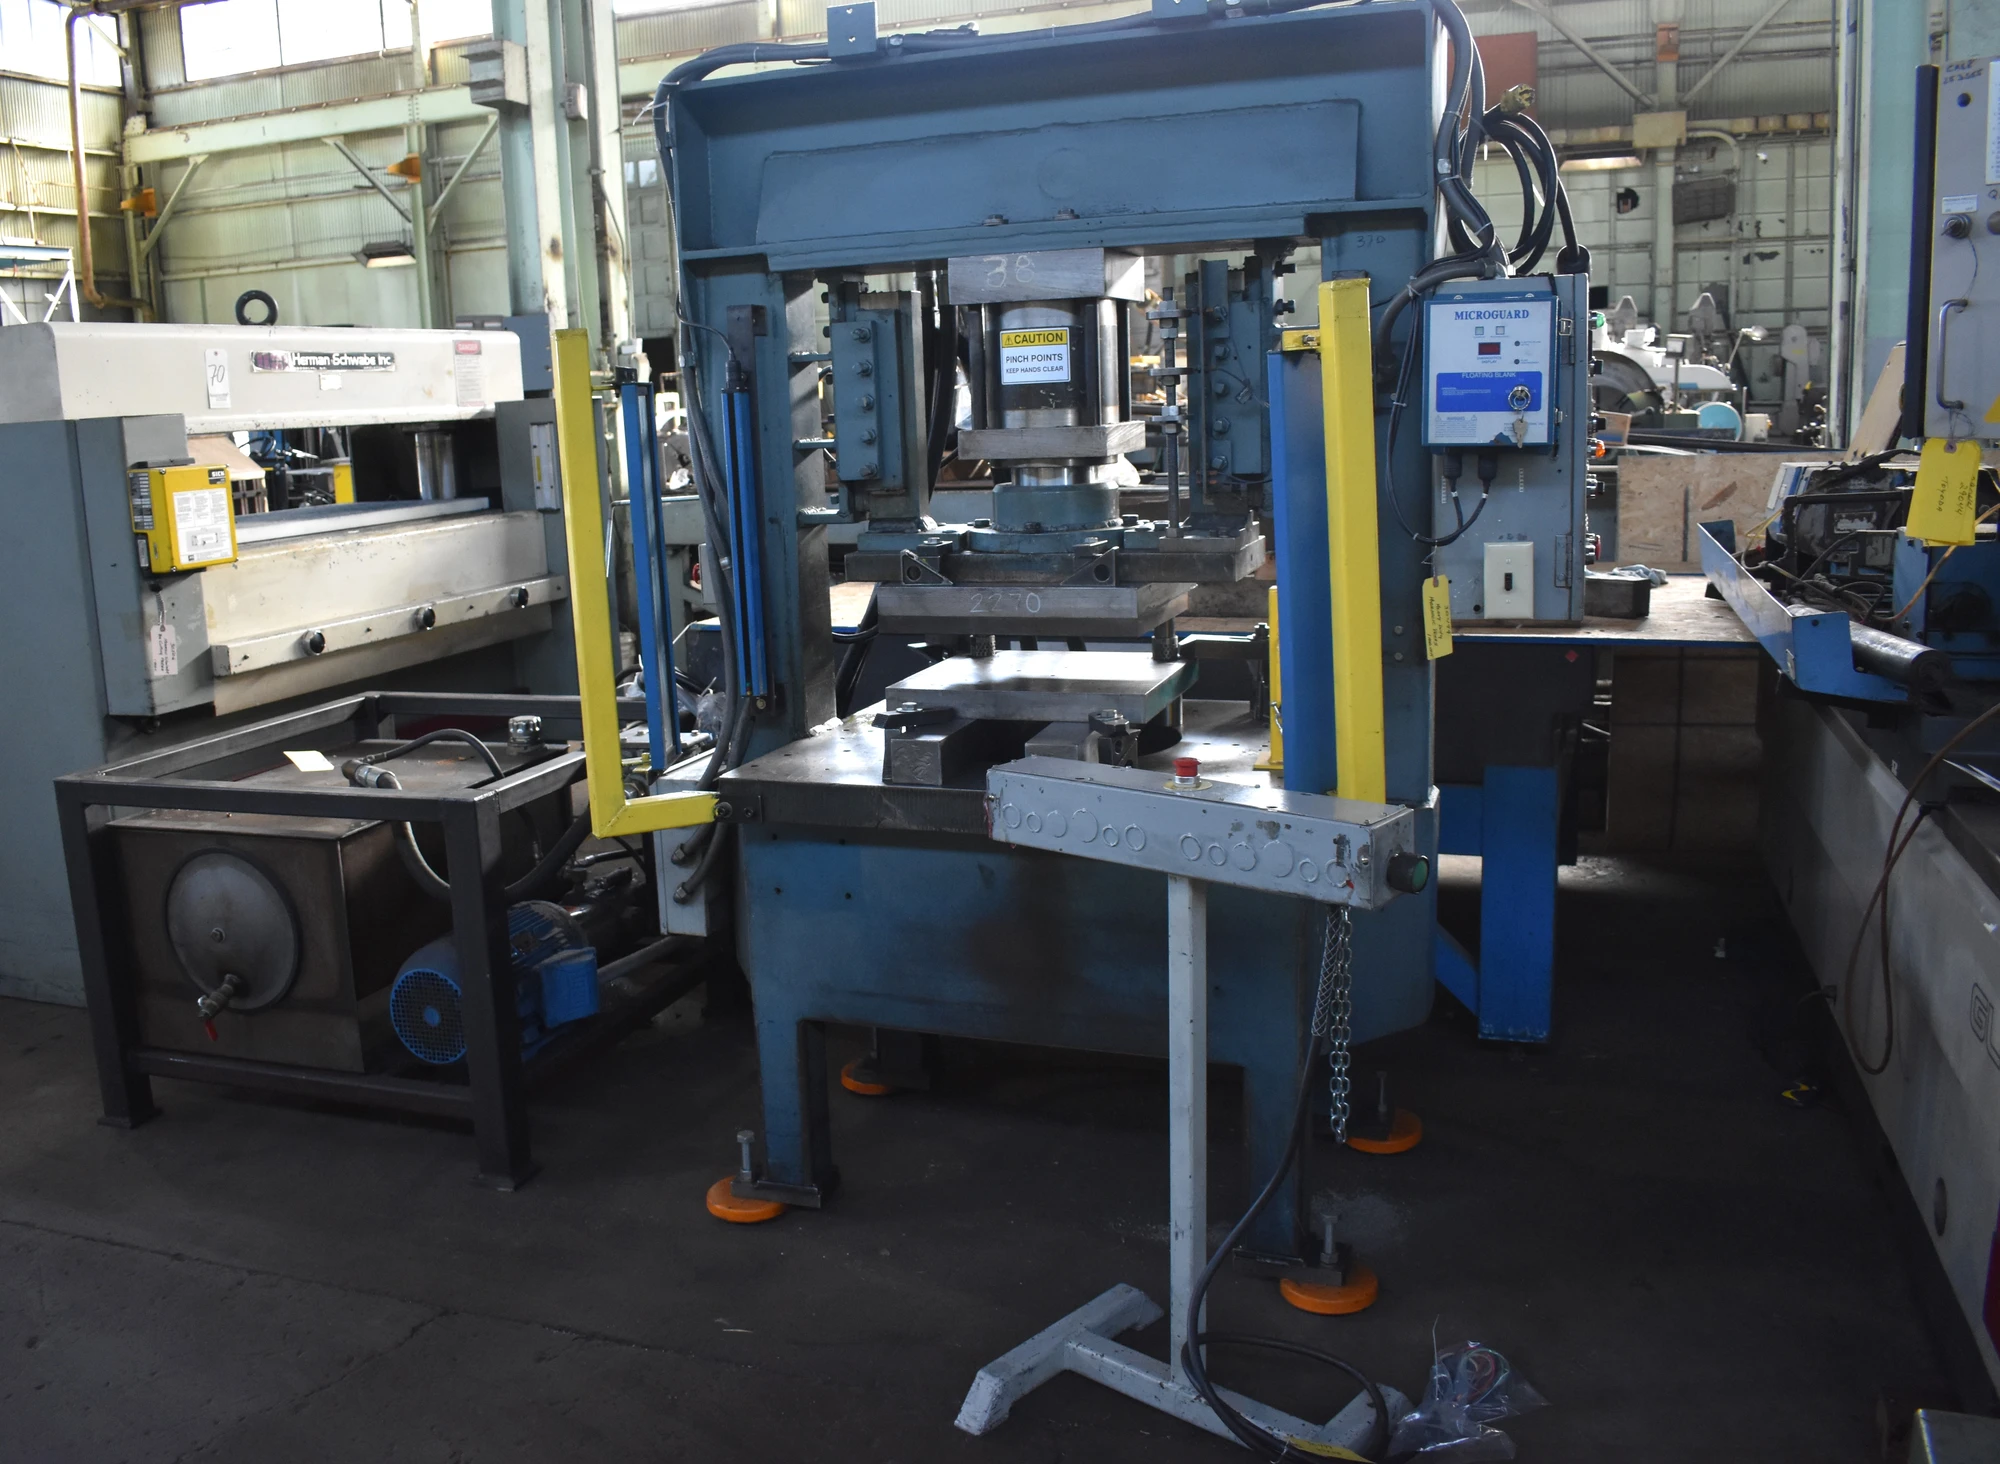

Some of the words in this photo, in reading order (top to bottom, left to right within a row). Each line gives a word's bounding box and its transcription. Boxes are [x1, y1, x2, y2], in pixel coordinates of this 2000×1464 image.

[983, 255, 1035, 288] 38
[1454, 309, 1530, 321] MICROGUARD
[1013, 332, 1064, 345] CAUTION
[292, 352, 331, 366] Herman
[377, 353, 392, 366] Inc
[1005, 355, 1029, 364] PINCH
[1031, 353, 1064, 363] POINTS
[207, 364, 226, 387] 70
[1005, 367, 1019, 375] KEEP
[1020, 366, 1041, 374] HANDS
[1042, 365, 1064, 373] CLEAR
[970, 592, 1041, 613] 2270
